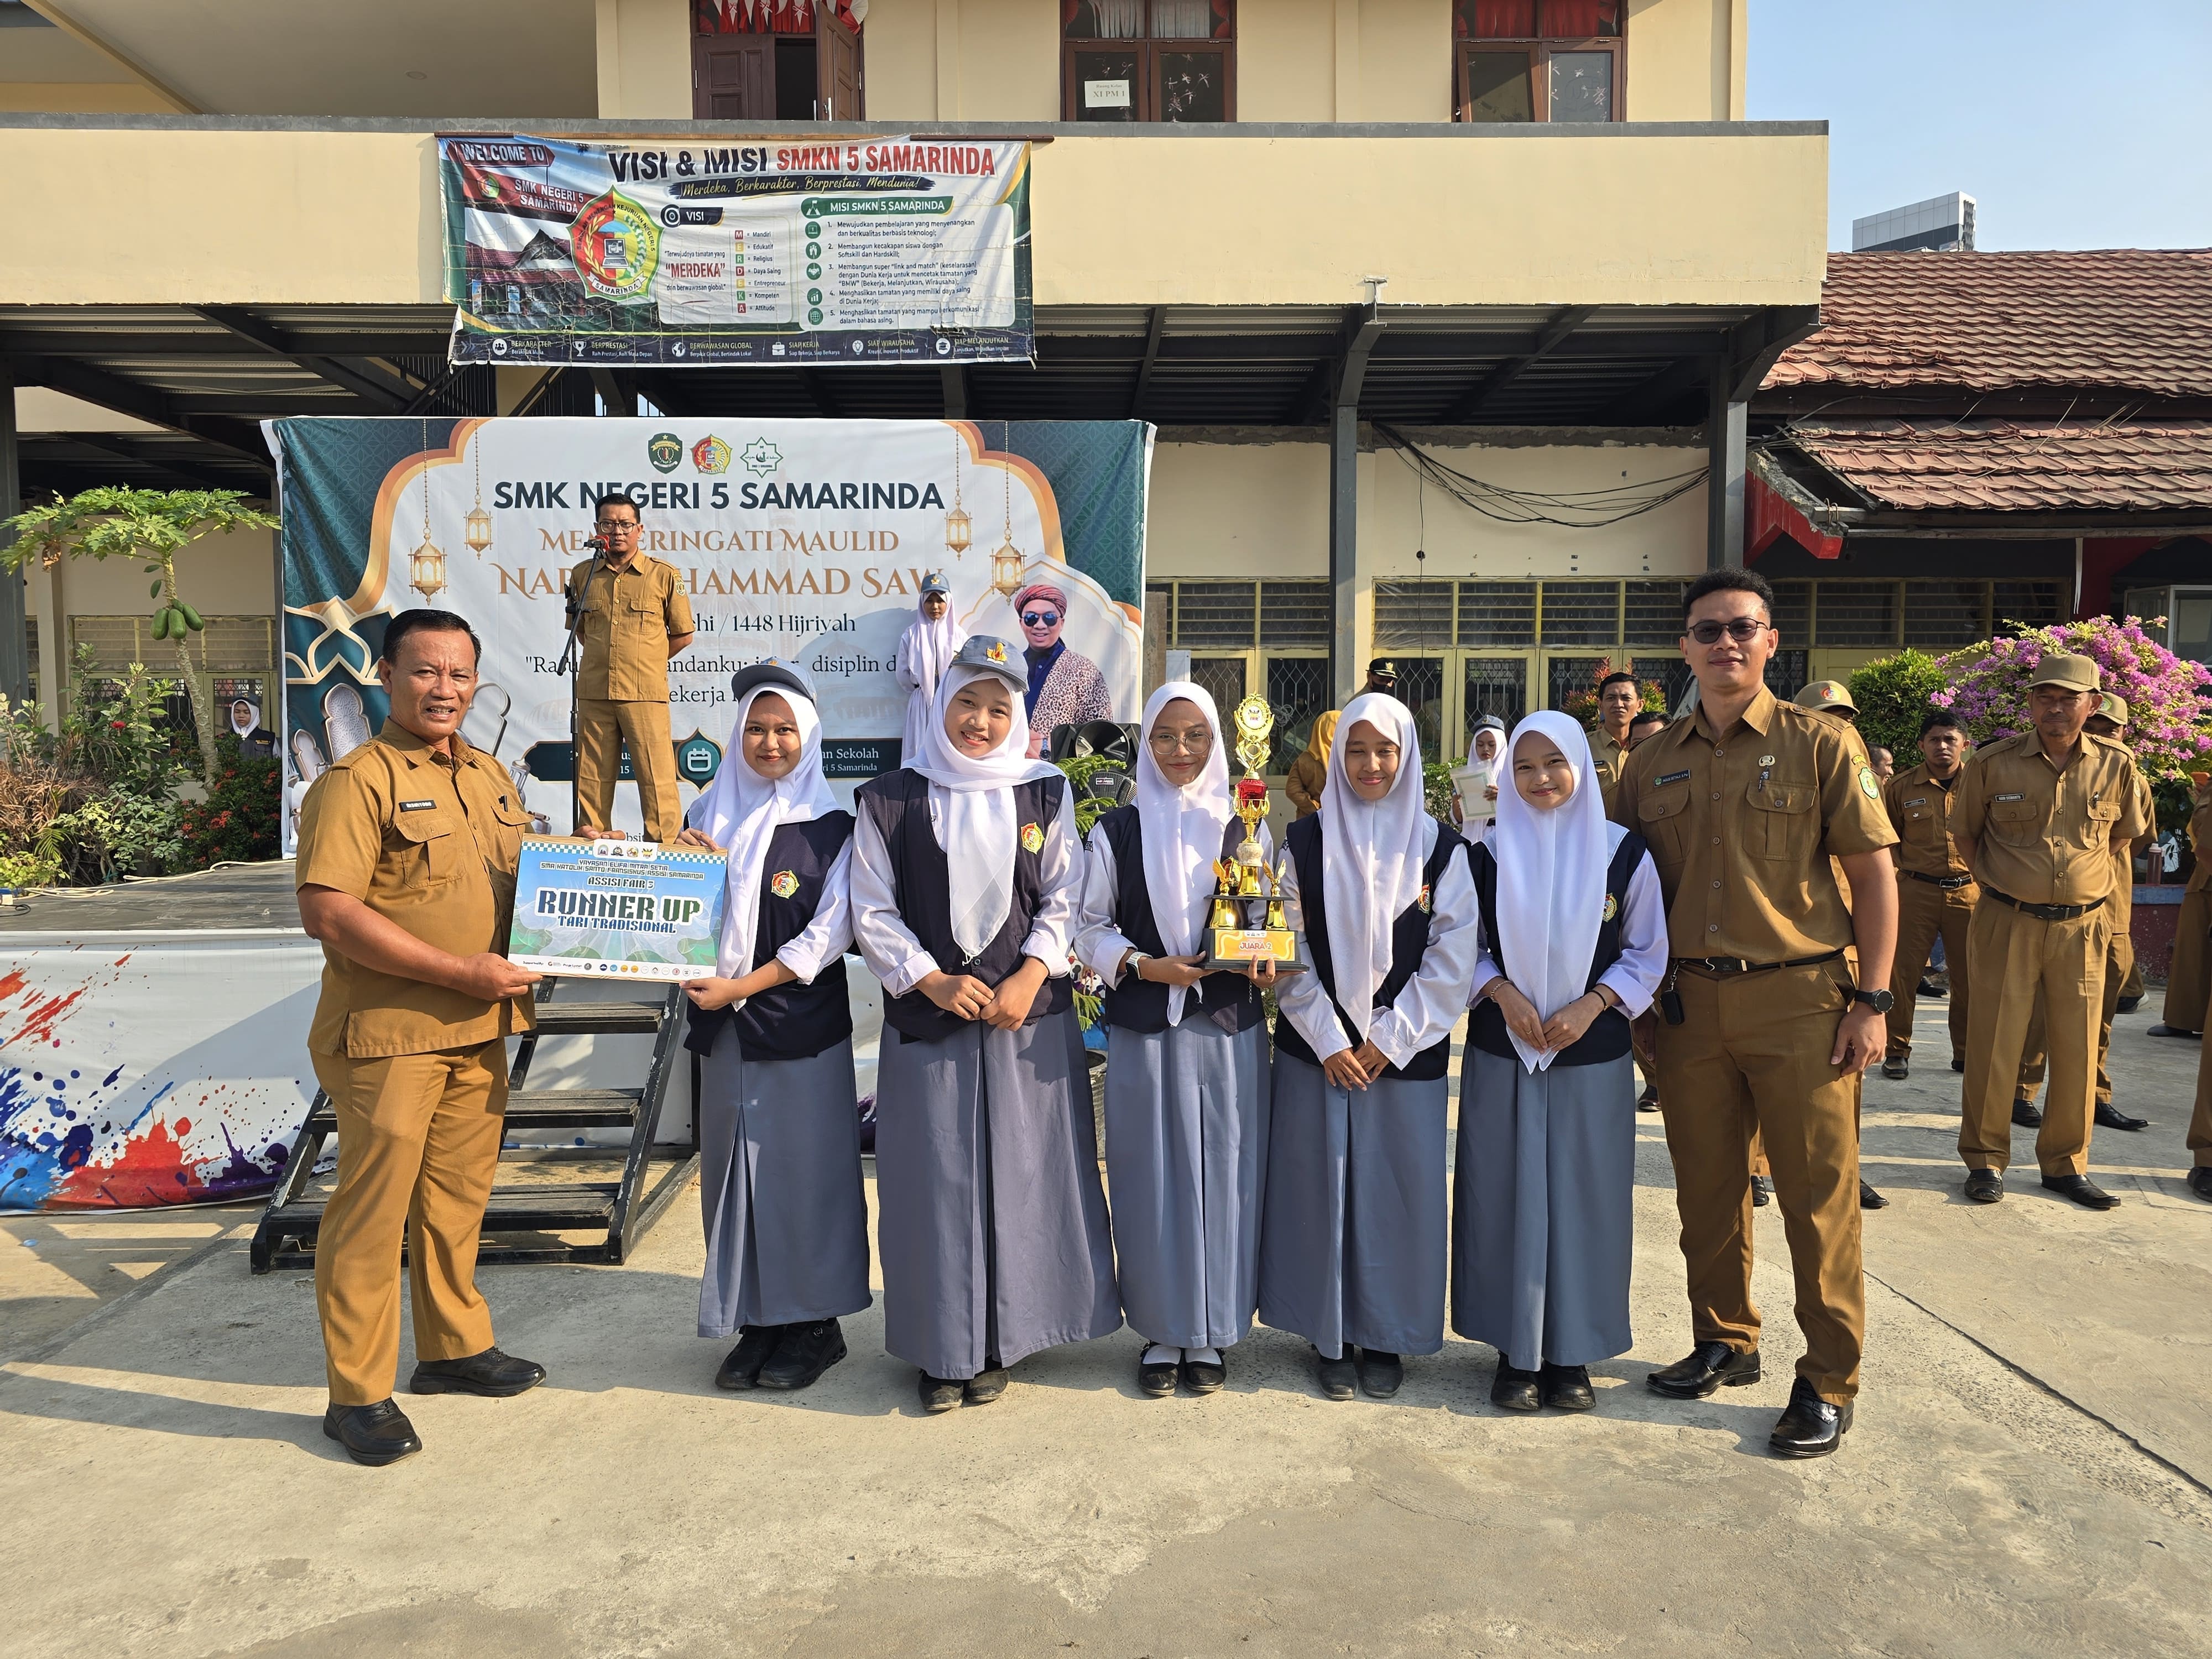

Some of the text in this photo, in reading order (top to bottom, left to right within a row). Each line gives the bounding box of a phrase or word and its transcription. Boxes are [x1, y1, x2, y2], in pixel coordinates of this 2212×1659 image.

[460, 143, 545, 161] WELCOME TO
[609, 145, 995, 182] VISI & MISI SMKN 5 SAMARINDA
[515, 179, 584, 203] SMK NEGERI 5
[683, 175, 920, 197] Merdeka, Berkarakter, Berprestasi, Mendunia!
[520, 195, 578, 213] SAMARINDA
[831, 200, 945, 212] MISI SMKN 5 SAMARINDA
[588, 204, 615, 221] MENENGAH
[617, 204, 644, 223] KEJURUAN
[643, 222, 655, 247] NEGERI
[686, 212, 704, 221] VISI
[875, 221, 914, 229] pembelajaran
[940, 261, 977, 269] (keselarasan)
[595, 283, 639, 295] SAMARINDA
[861, 280, 886, 288] (Bekerja,
[925, 278, 959, 286] Wirausaha);
[493, 482, 570, 509] SMK
[710, 482, 729, 509] 5
[739, 482, 946, 509] SAMARINDA
[778, 528, 899, 556] MAULID
[733, 614, 774, 632] 1448
[779, 613, 856, 638] Hijriyah
[812, 655, 880, 677] disiplin
[836, 748, 879, 759] Sekolah
[837, 763, 878, 771] Samarinda
[607, 867, 645, 875] FRANSISKUS
[669, 872, 704, 880] SAMARINDA
[588, 877, 654, 889] ASSISI FAIR 3
[538, 890, 701, 923] RUNNER UP
[558, 915, 676, 933] TARI TRADISIONAL
[1239, 942, 1265, 950] JUARA
